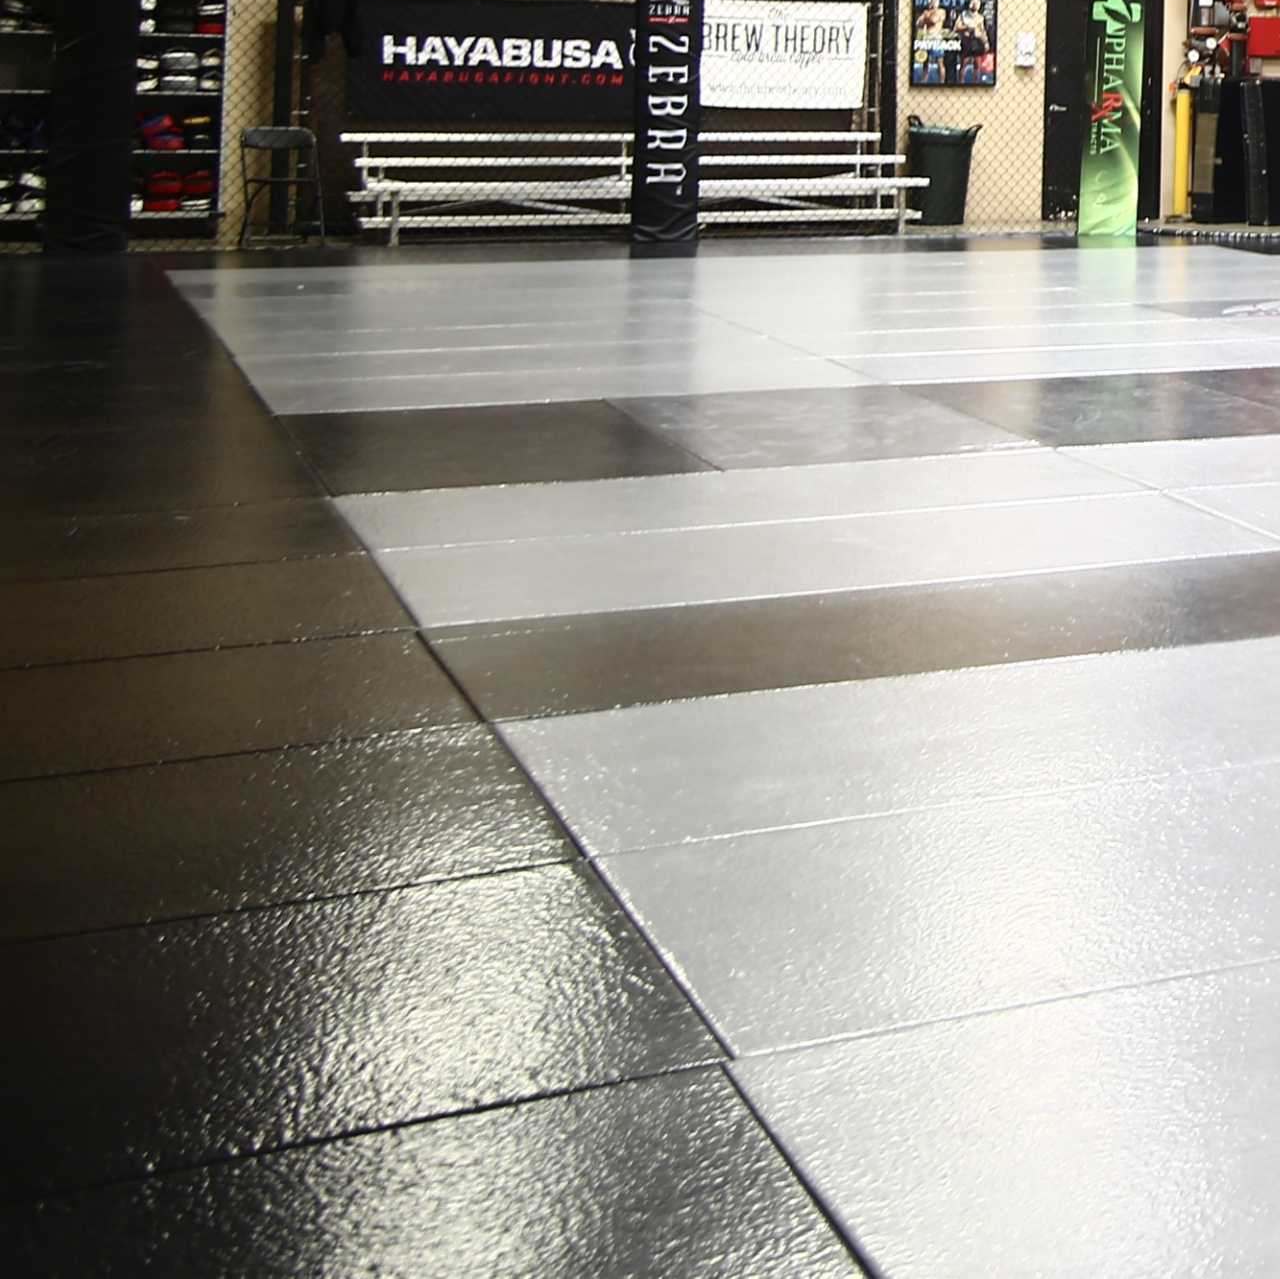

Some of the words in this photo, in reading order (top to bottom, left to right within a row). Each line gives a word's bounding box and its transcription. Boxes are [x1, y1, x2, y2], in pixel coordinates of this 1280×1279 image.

[382, 34, 624, 70] HAYABUSA
[702, 22, 764, 53] BREW
[771, 24, 855, 55] THEORY
[646, 34, 690, 185] ZEBRA
